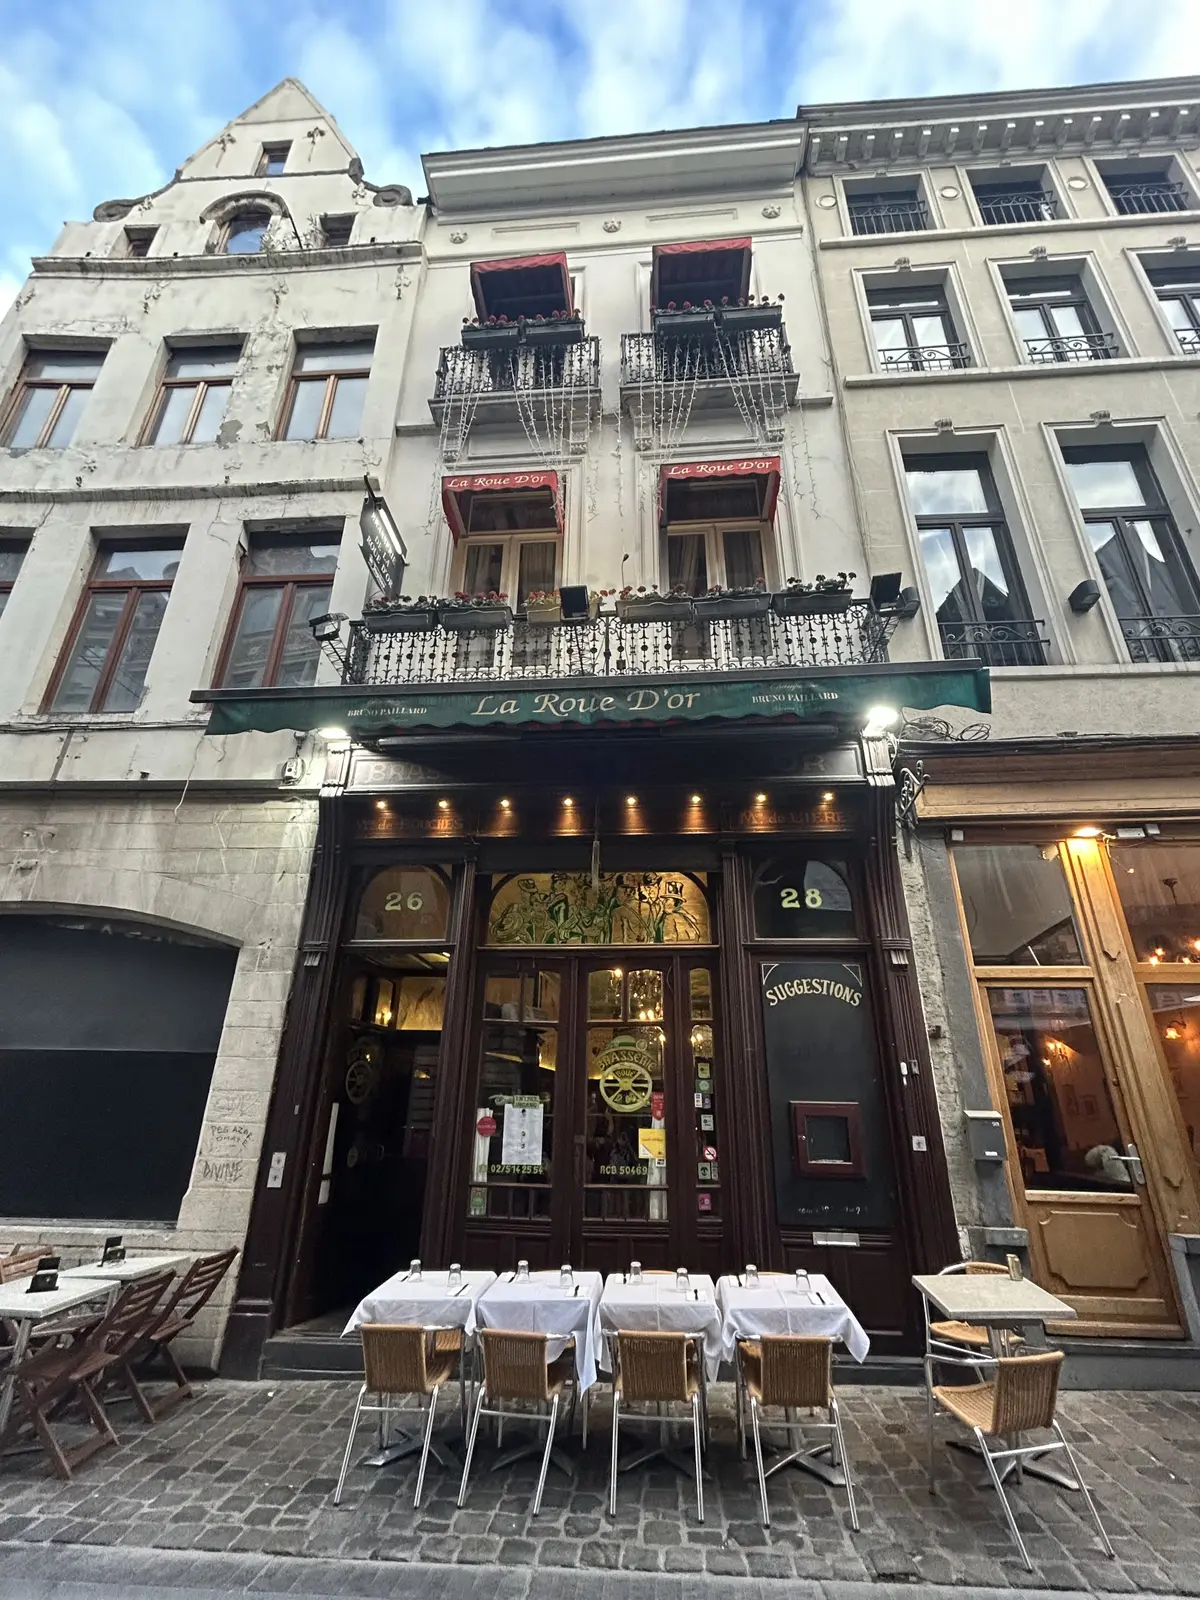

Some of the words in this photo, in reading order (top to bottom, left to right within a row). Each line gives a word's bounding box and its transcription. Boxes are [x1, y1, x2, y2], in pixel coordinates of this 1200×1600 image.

[669, 465, 689, 475] La
[697, 462, 734, 474] Roue
[738, 459, 773, 470] D'or
[447, 477, 469, 488] La
[474, 475, 510, 488] Roue
[514, 473, 546, 485] D'or
[470, 695, 520, 716] La
[532, 693, 616, 717] Roue
[627, 688, 700, 711] D'or
[752, 693, 785, 703] BRUNO
[788, 692, 839, 702] PAILLARD
[347, 708, 378, 717] BRUNO
[380, 707, 428, 716] PAILLARD
[385, 891, 424, 911] 26
[780, 888, 823, 909] 28
[765, 978, 862, 1007] SUGGESTIONS
[596, 1050, 657, 1072] BRASSERIE
[490, 1164, 521, 1174] 02/514
[521, 1165, 532, 1174] 25
[533, 1166, 544, 1174] 54
[600, 1164, 617, 1174] RCB
[619, 1165, 653, 1175] 50469
